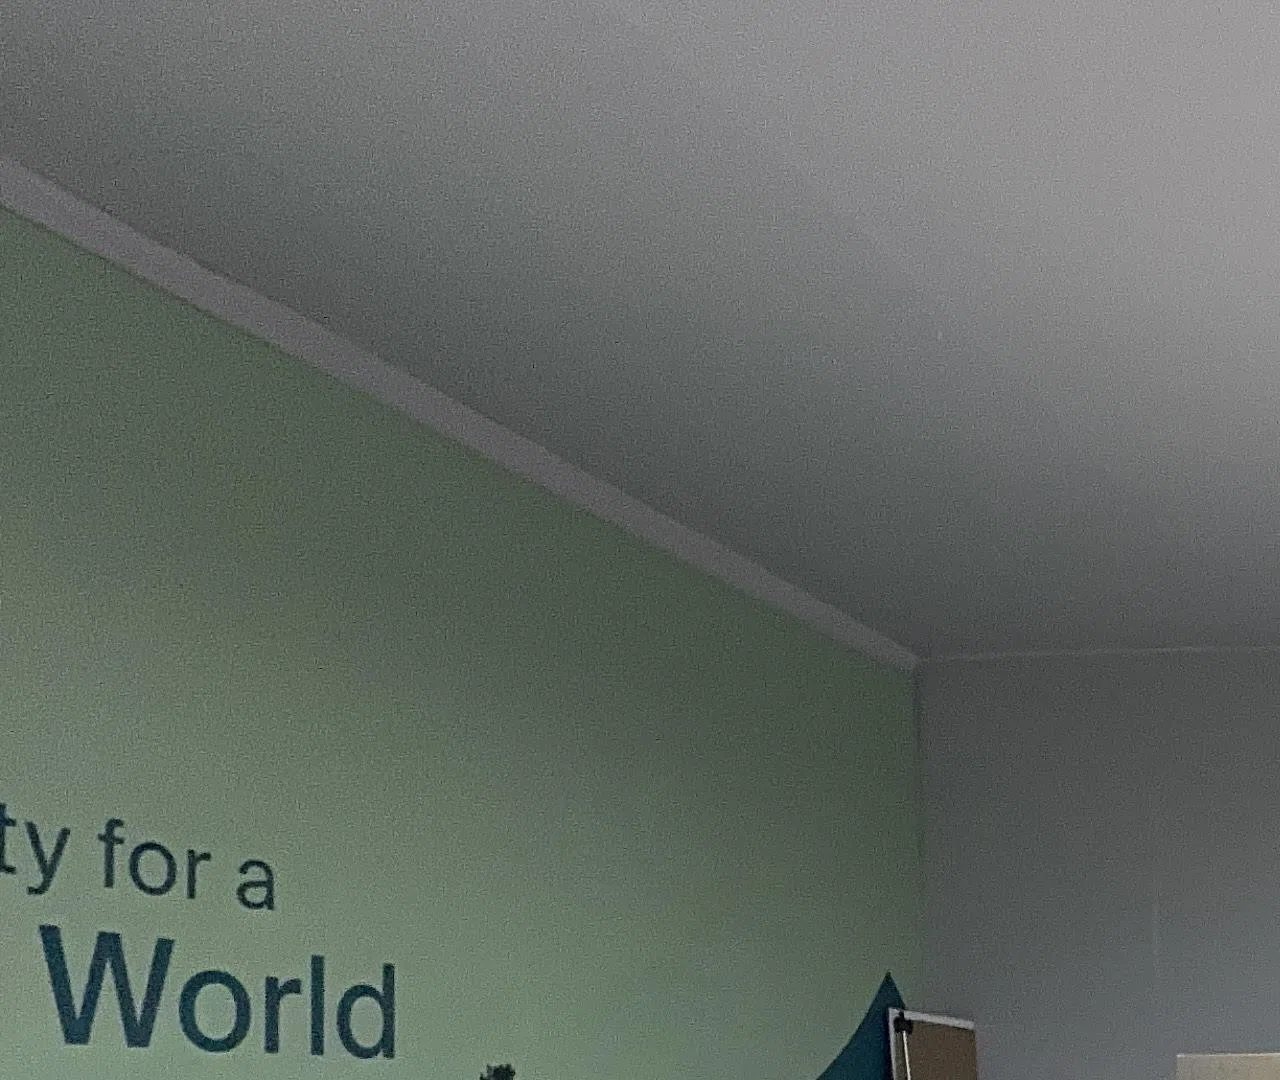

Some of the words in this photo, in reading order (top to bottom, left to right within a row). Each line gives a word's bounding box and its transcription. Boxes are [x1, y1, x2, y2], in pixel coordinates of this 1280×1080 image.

[98, 818, 211, 899] for
[236, 859, 275, 911] a
[39, 924, 396, 1060] World
